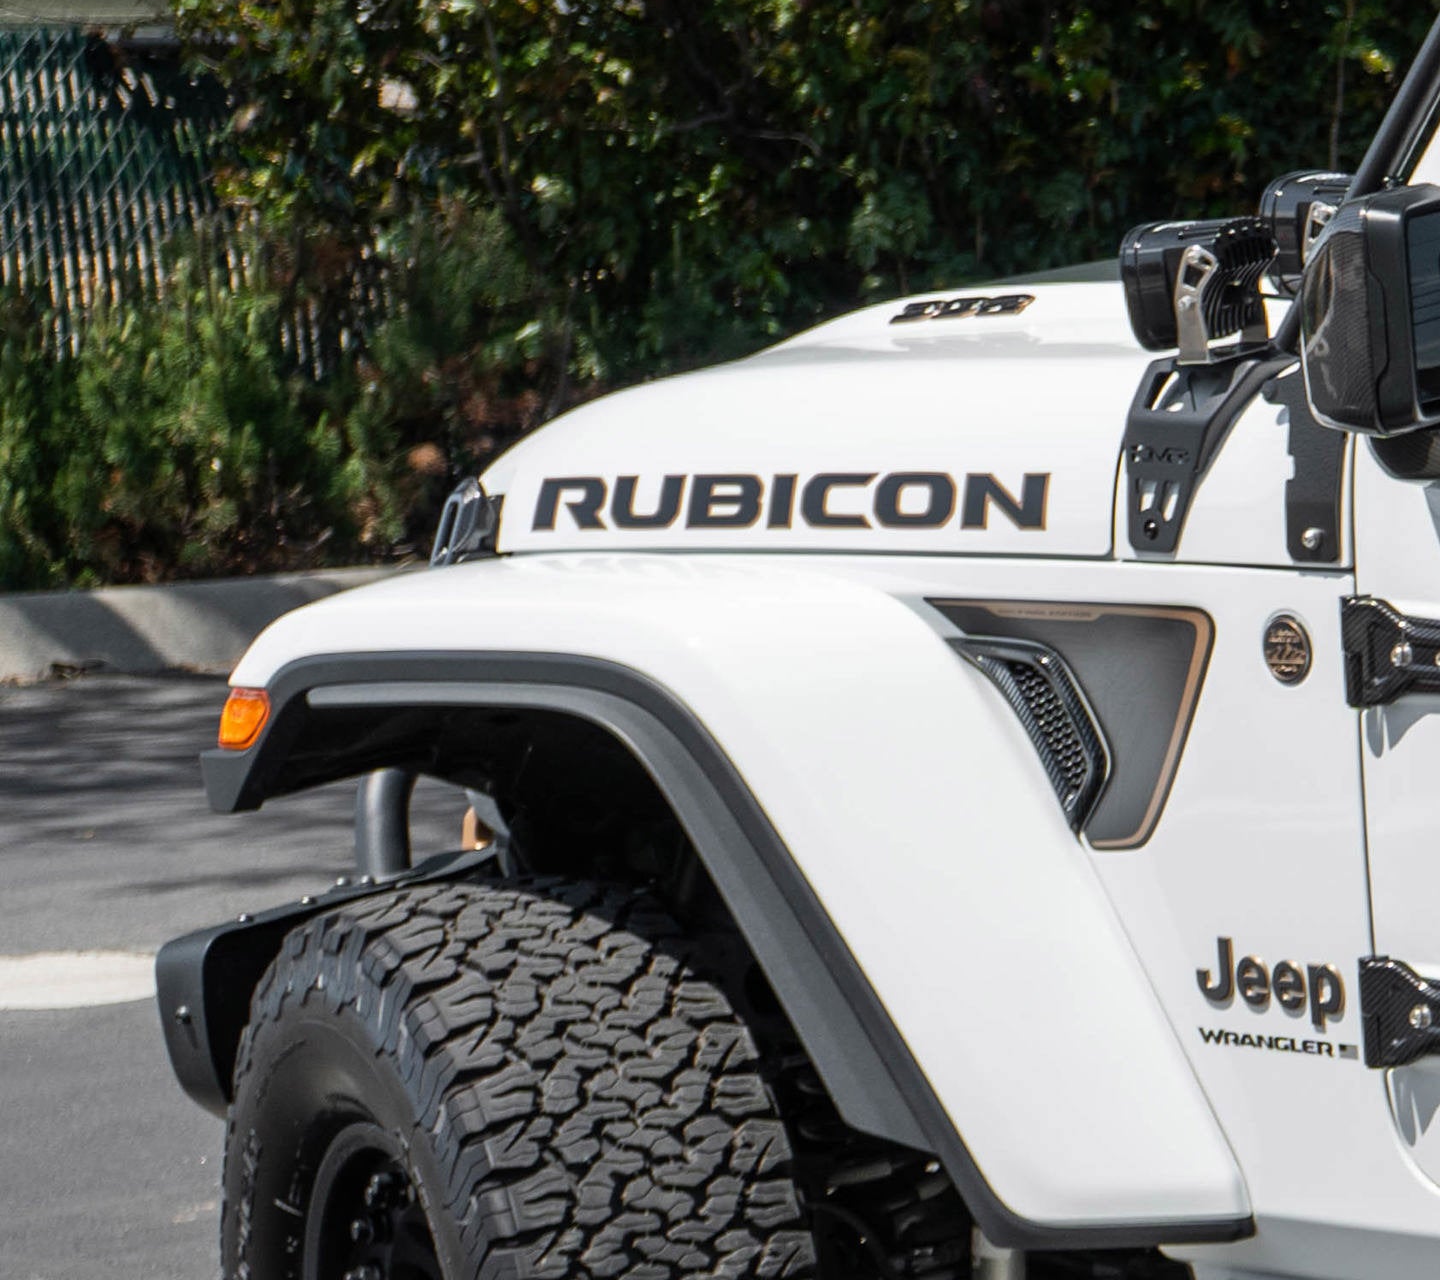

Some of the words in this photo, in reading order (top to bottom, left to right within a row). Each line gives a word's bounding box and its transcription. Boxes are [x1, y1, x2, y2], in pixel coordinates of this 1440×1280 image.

[530, 471, 1052, 532] RUBICON
[1196, 936, 1346, 1032] Jeep
[1198, 1026, 1334, 1058] WRANGLER
